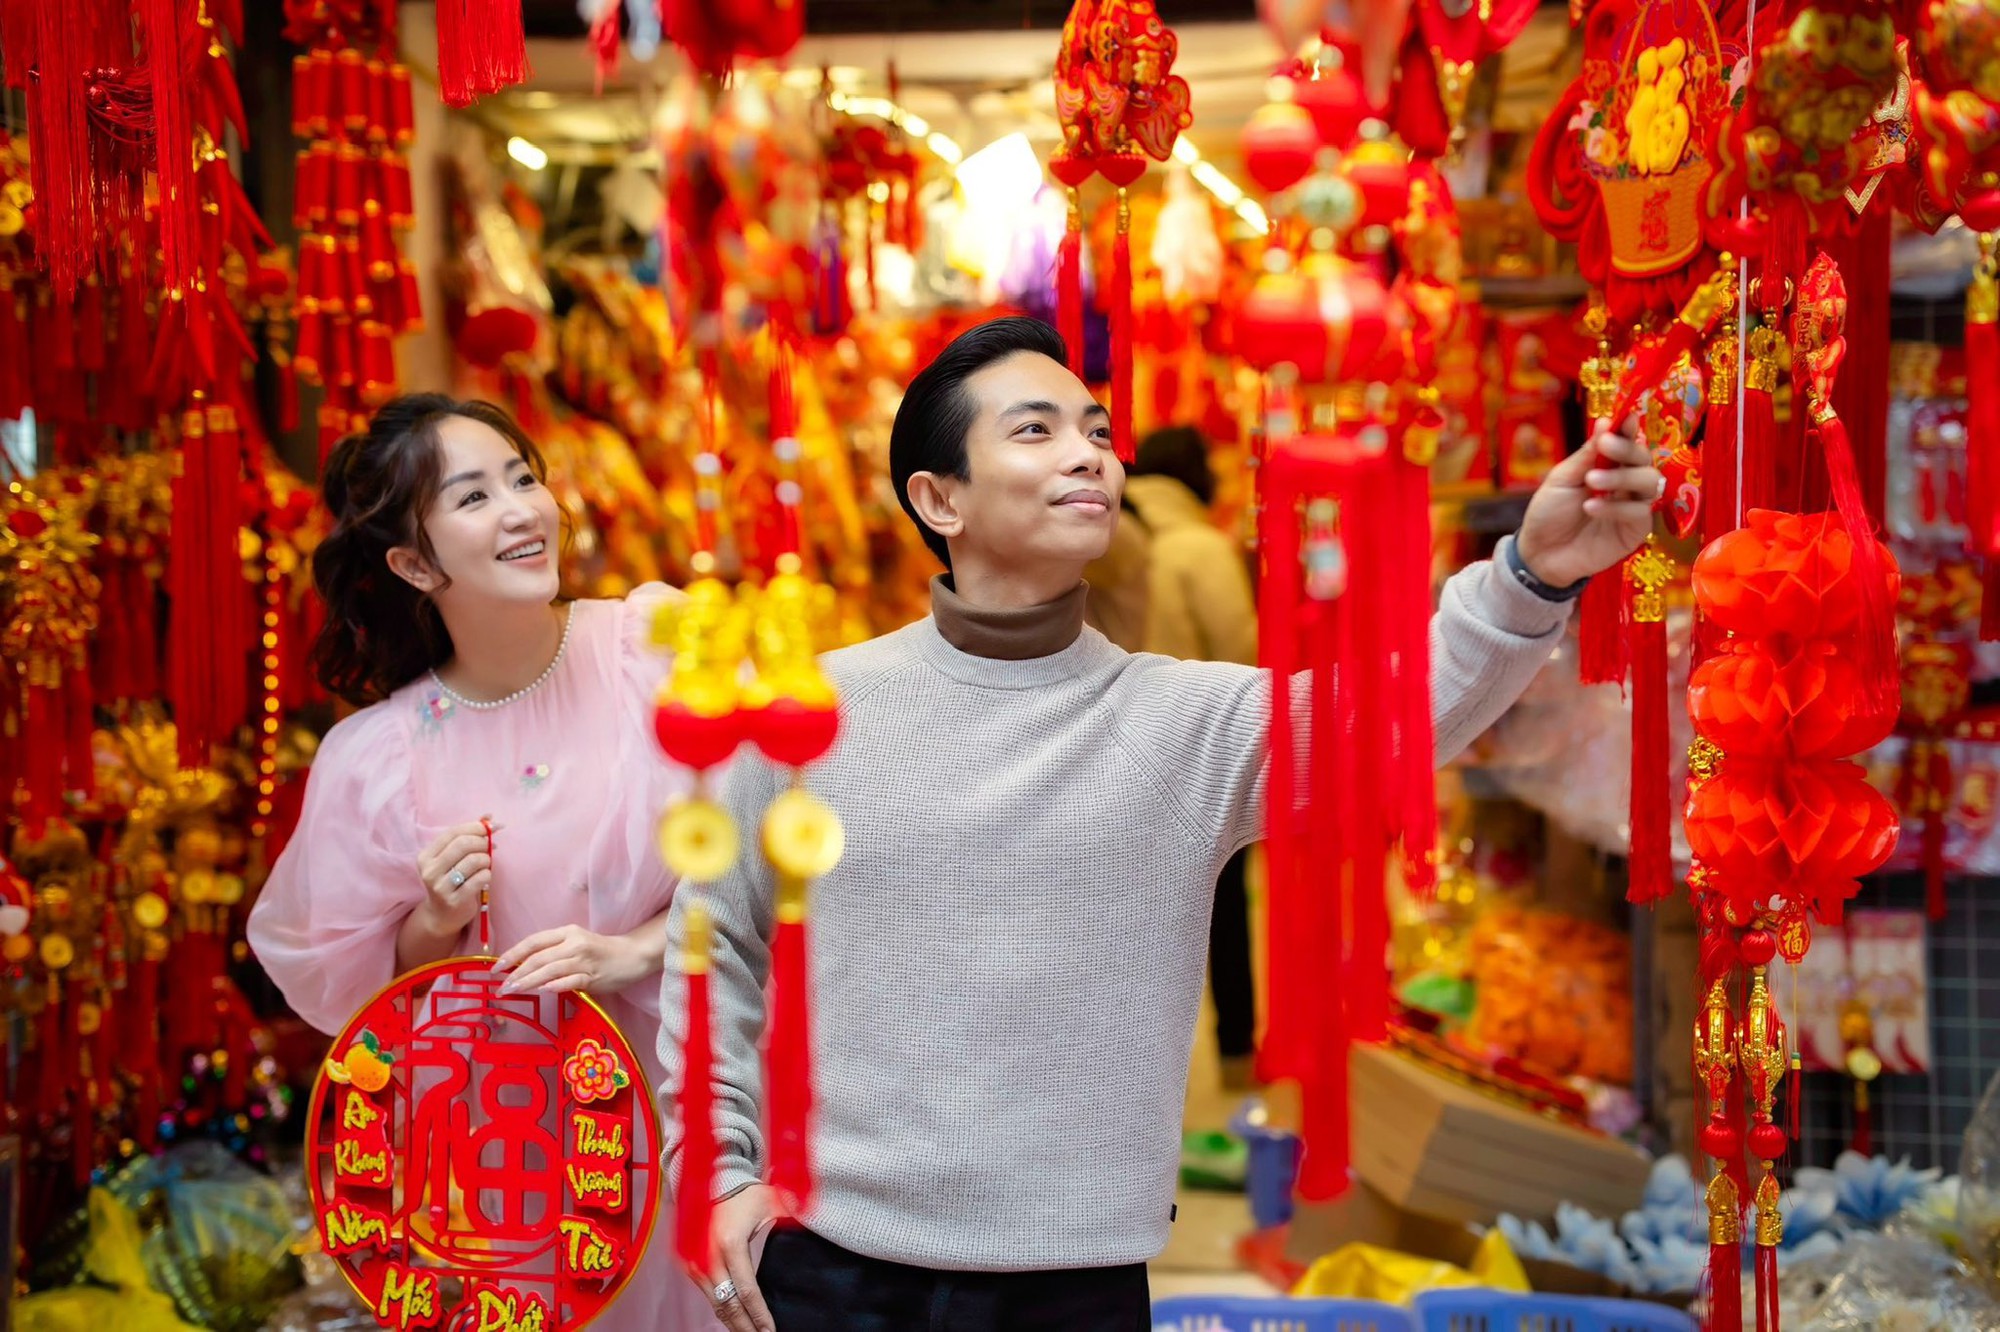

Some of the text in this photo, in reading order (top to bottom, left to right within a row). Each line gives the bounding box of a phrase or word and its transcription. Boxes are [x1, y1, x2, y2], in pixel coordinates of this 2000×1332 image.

[1782, 920, 1803, 956] 福
[344, 1091, 378, 1130] An
[405, 1036, 563, 1240] 福
[573, 1114, 624, 1159] Thịnh
[335, 1139, 386, 1183] Khang
[567, 1163, 622, 1208] Vượng
[326, 1204, 387, 1249] Năm
[559, 1220, 613, 1271] Tài
